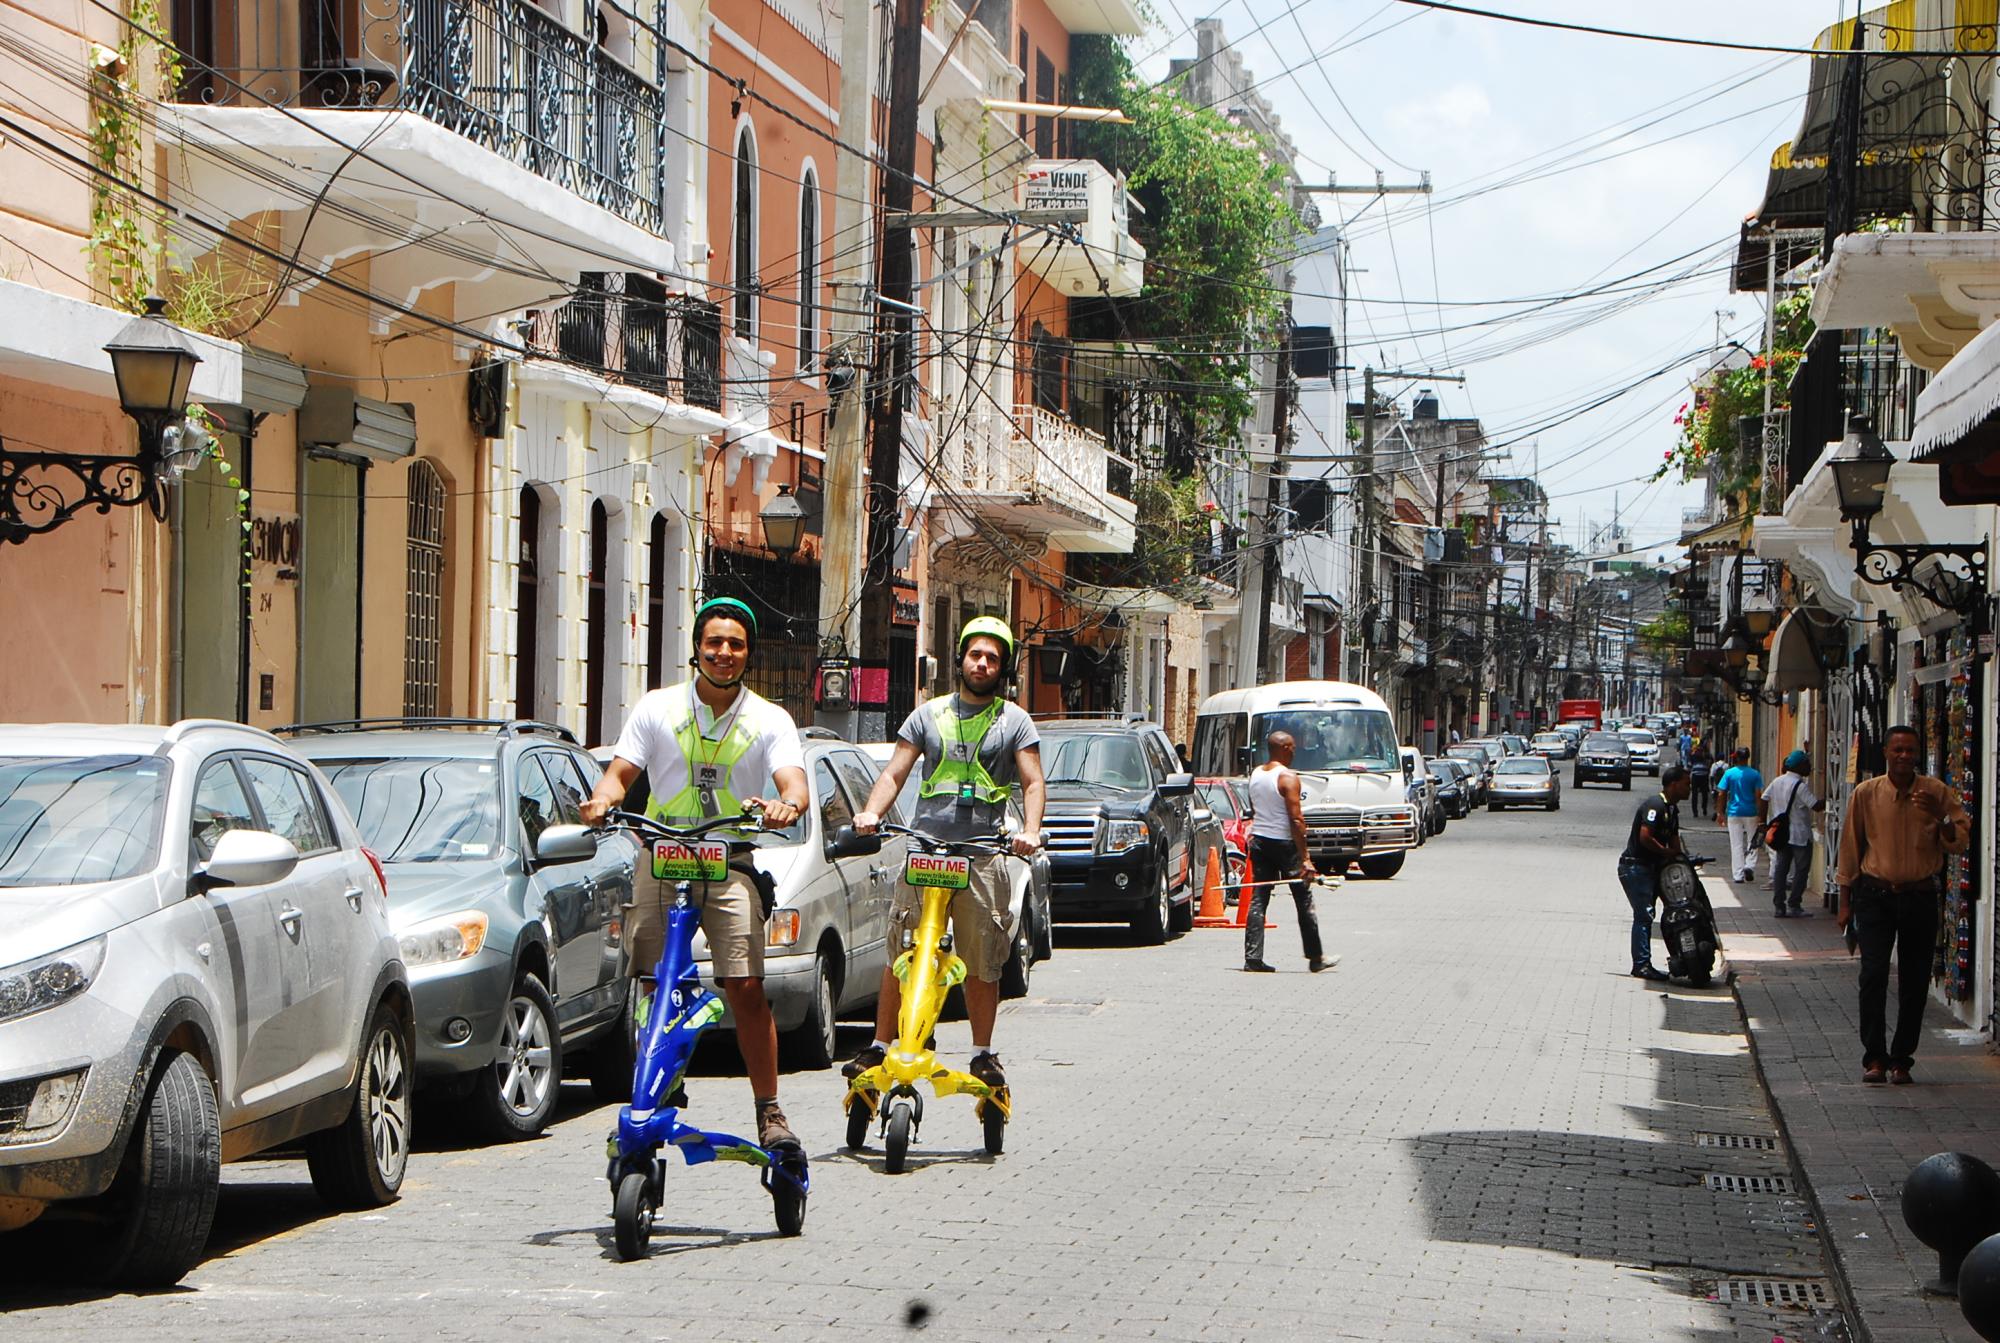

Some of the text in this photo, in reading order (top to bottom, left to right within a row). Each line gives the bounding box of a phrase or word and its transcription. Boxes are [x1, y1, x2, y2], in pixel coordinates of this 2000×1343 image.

[1050, 171, 1087, 189] VENDE
[657, 846, 723, 861] RENT ME
[911, 858, 966, 873] RENT ME
